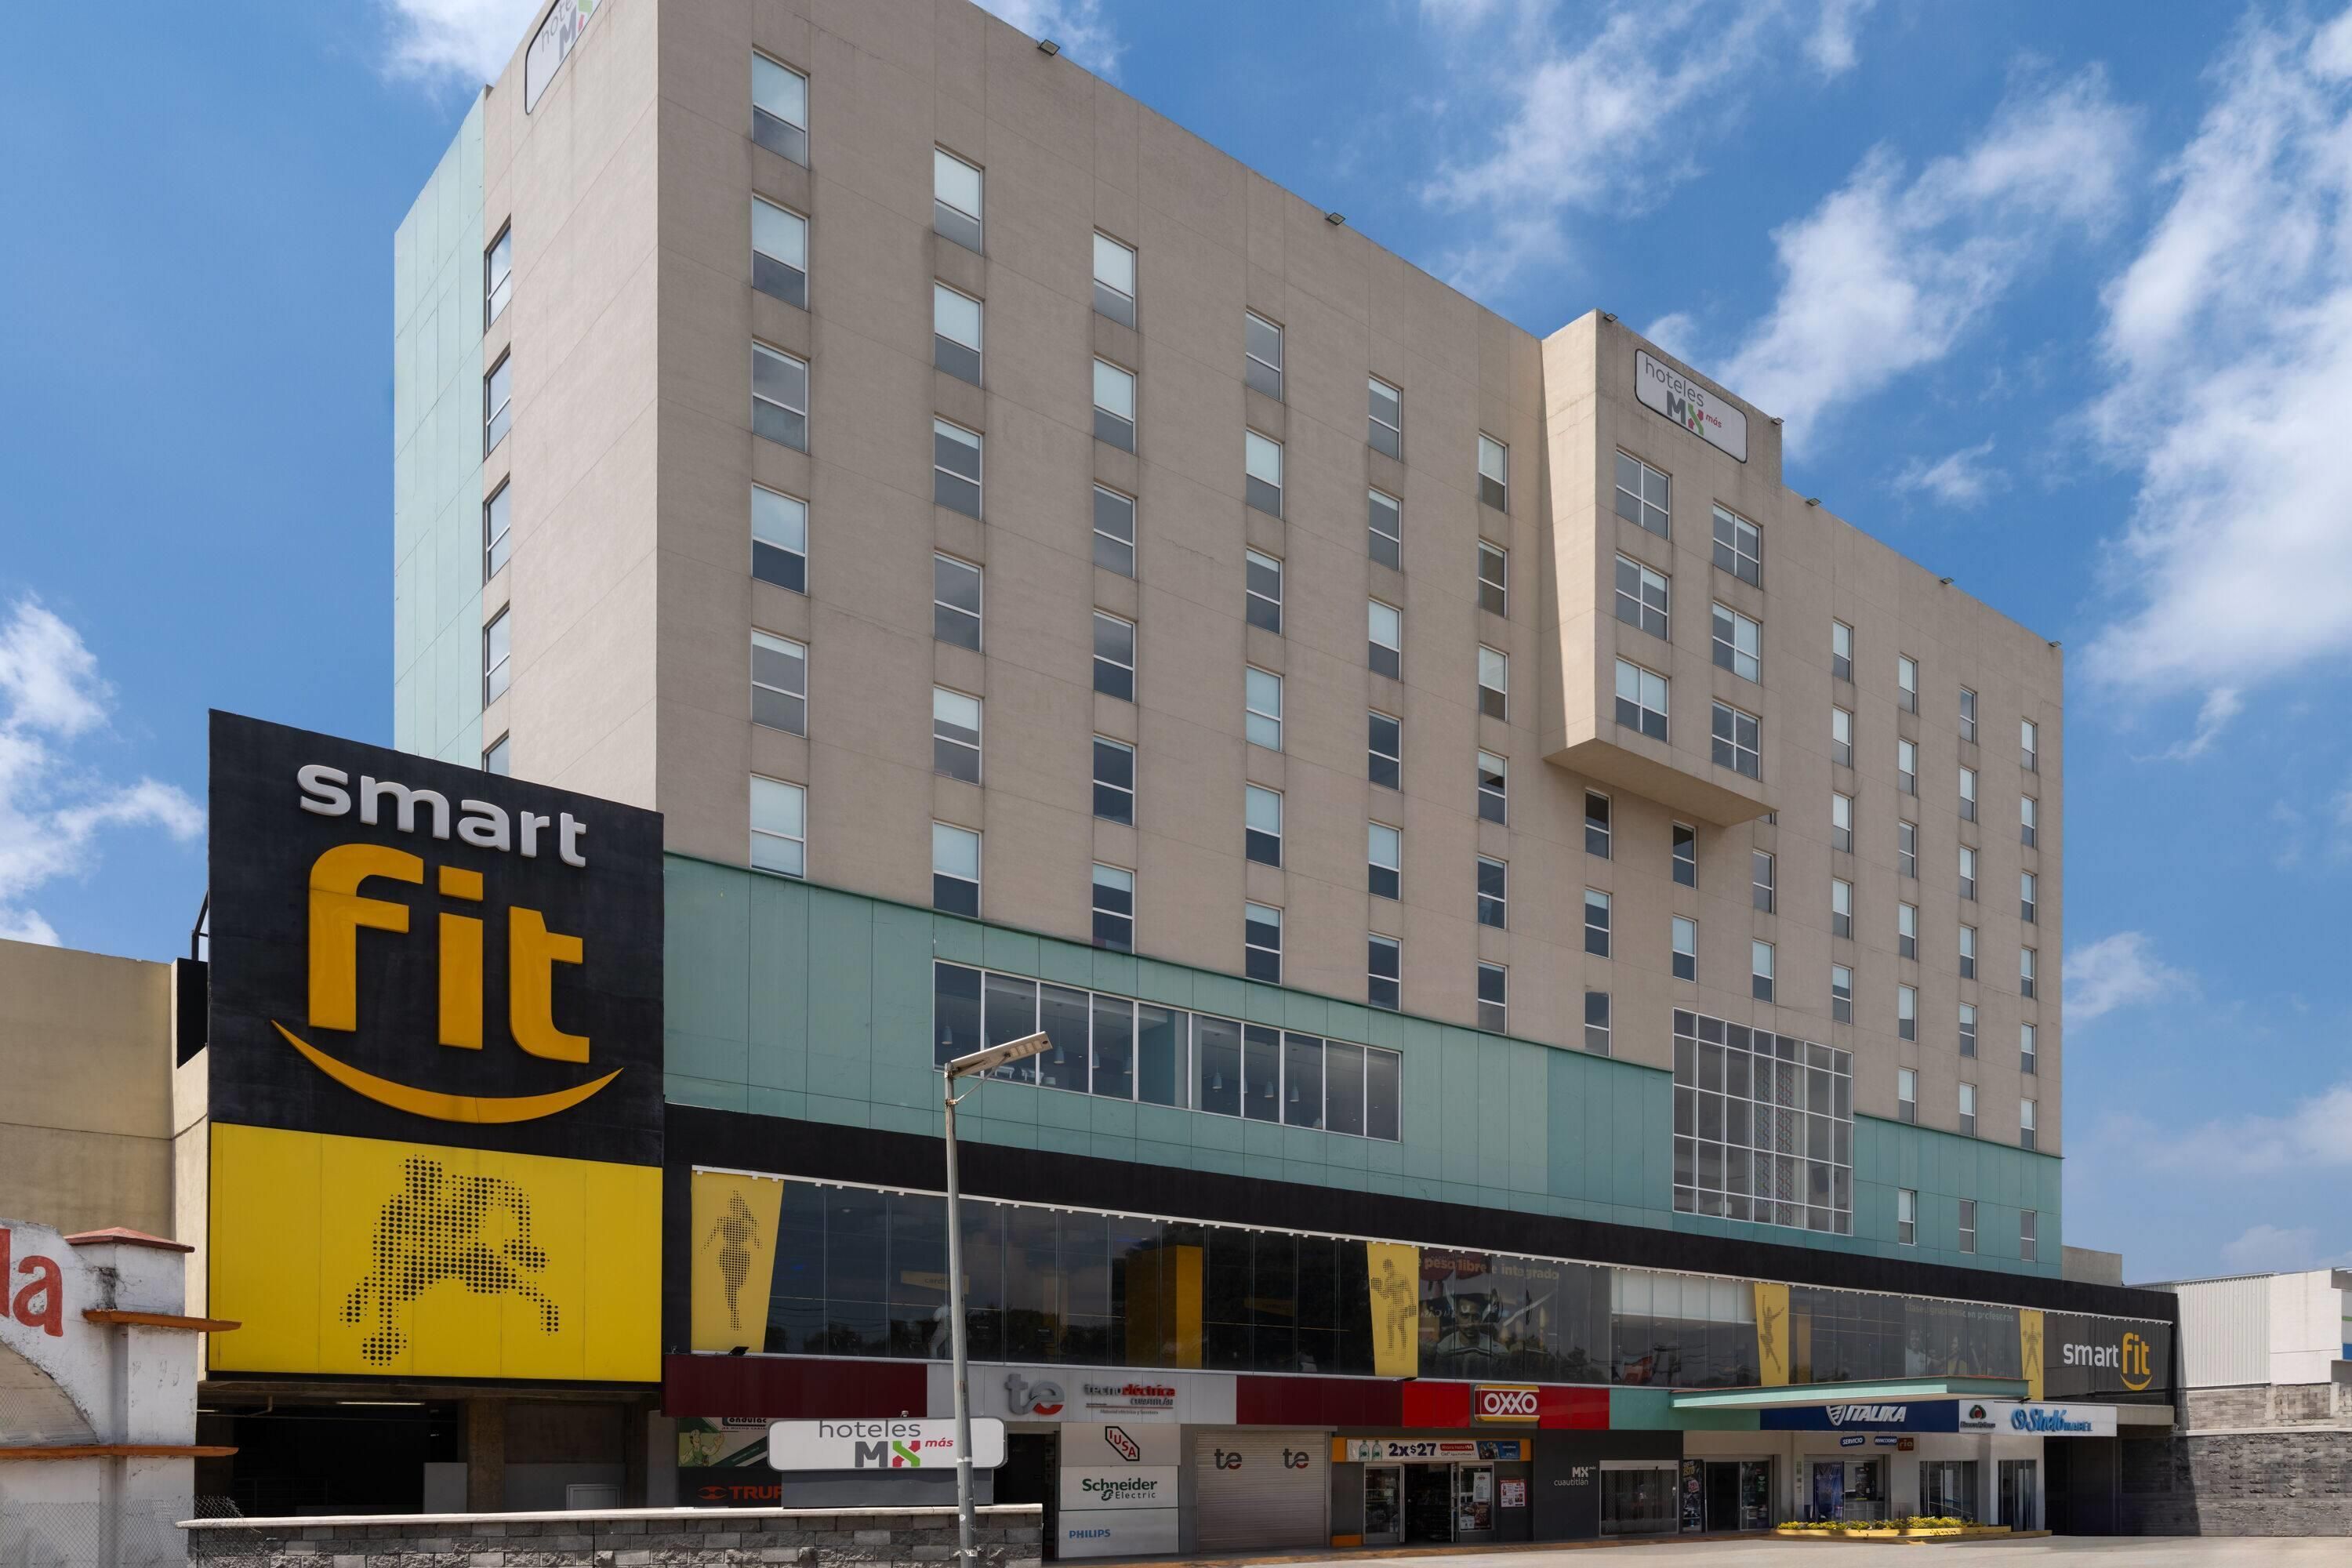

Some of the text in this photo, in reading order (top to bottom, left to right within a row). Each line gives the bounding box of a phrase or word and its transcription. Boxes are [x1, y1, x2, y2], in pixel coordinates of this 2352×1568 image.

[1646, 357, 1704, 407] hoteles
[1667, 390, 1722, 437] MX más
[297, 764, 586, 867] smart
[309, 844, 590, 1064] fit
[1424, 1257, 1455, 1270] peso
[1455, 1258, 1486, 1272] libre
[1501, 1263, 1559, 1279] integrado
[2063, 1343, 2119, 1367] smart
[2122, 1332, 2151, 1375] fit
[1004, 1374, 1065, 1416] te
[1484, 1391, 1537, 1416] OXXO
[1844, 1405, 1907, 1421] ITALIKA
[819, 1420, 920, 1438] hoteles
[855, 1437, 953, 1468] MX más
[1109, 1430, 1137, 1457] IUSA
[1214, 1449, 1242, 1469] te
[1283, 1448, 1309, 1468] te
[1572, 1467, 1588, 1477] MX
[1082, 1478, 1158, 1491] Schneider
[1069, 1530, 1111, 1538] PHILIPS
